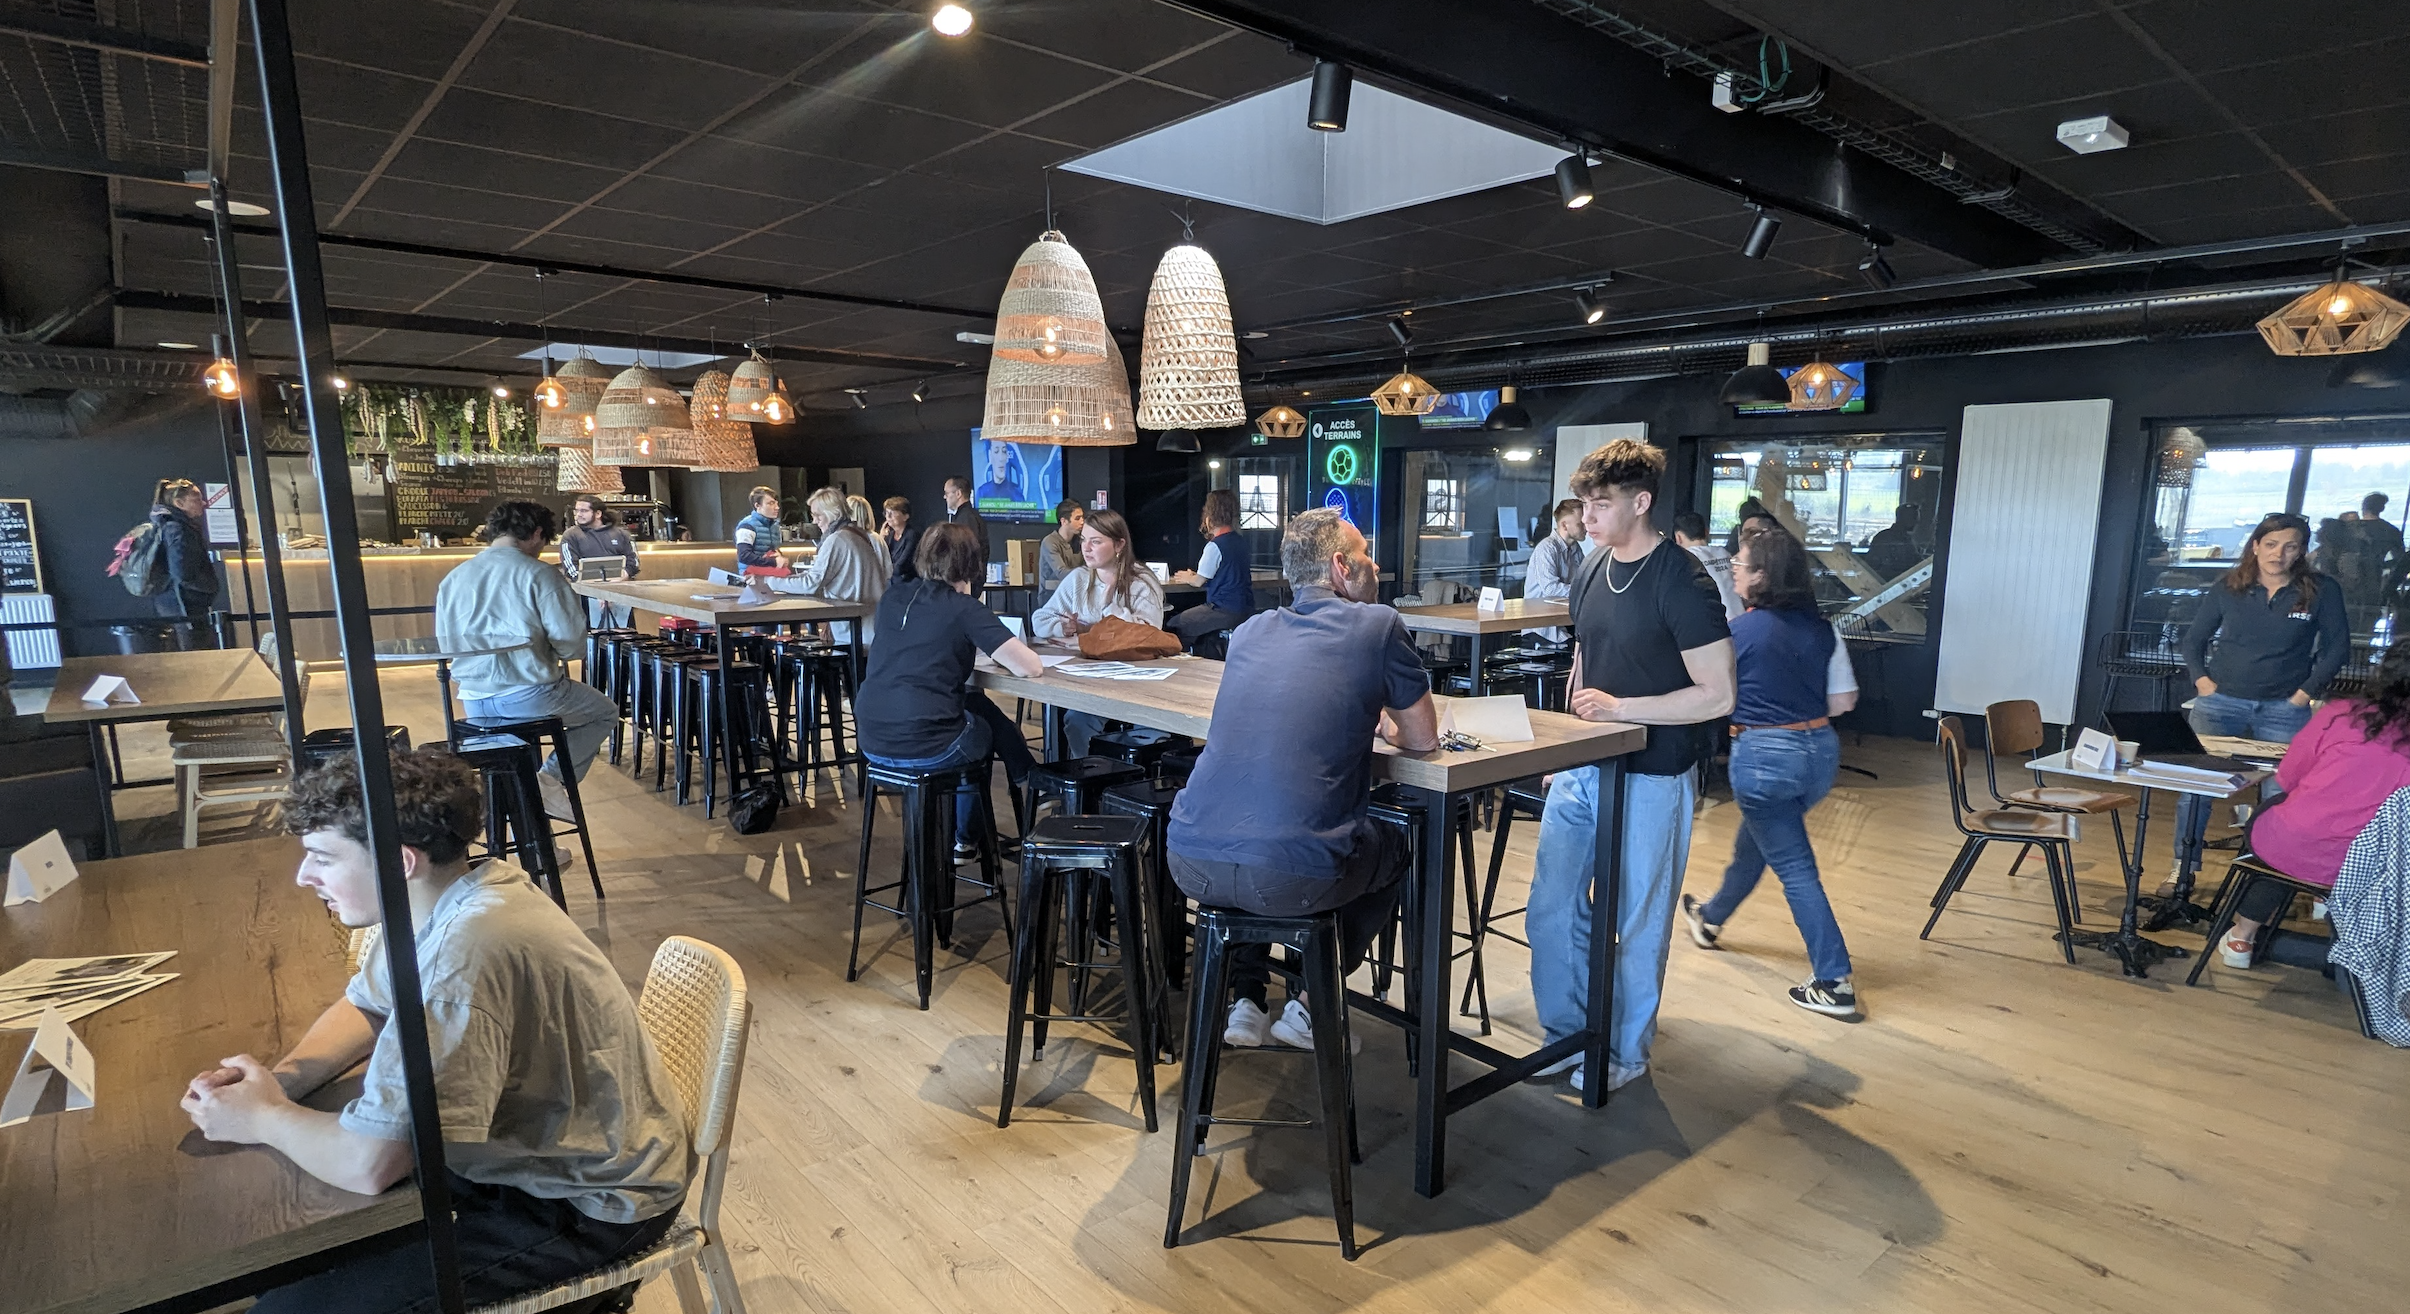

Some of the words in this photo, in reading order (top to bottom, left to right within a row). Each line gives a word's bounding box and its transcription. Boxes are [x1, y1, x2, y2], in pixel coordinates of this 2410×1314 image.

[1330, 419, 1355, 430] ACCÈS
[1324, 430, 1362, 440] TERRAINS
[397, 462, 436, 474] ANINIS
